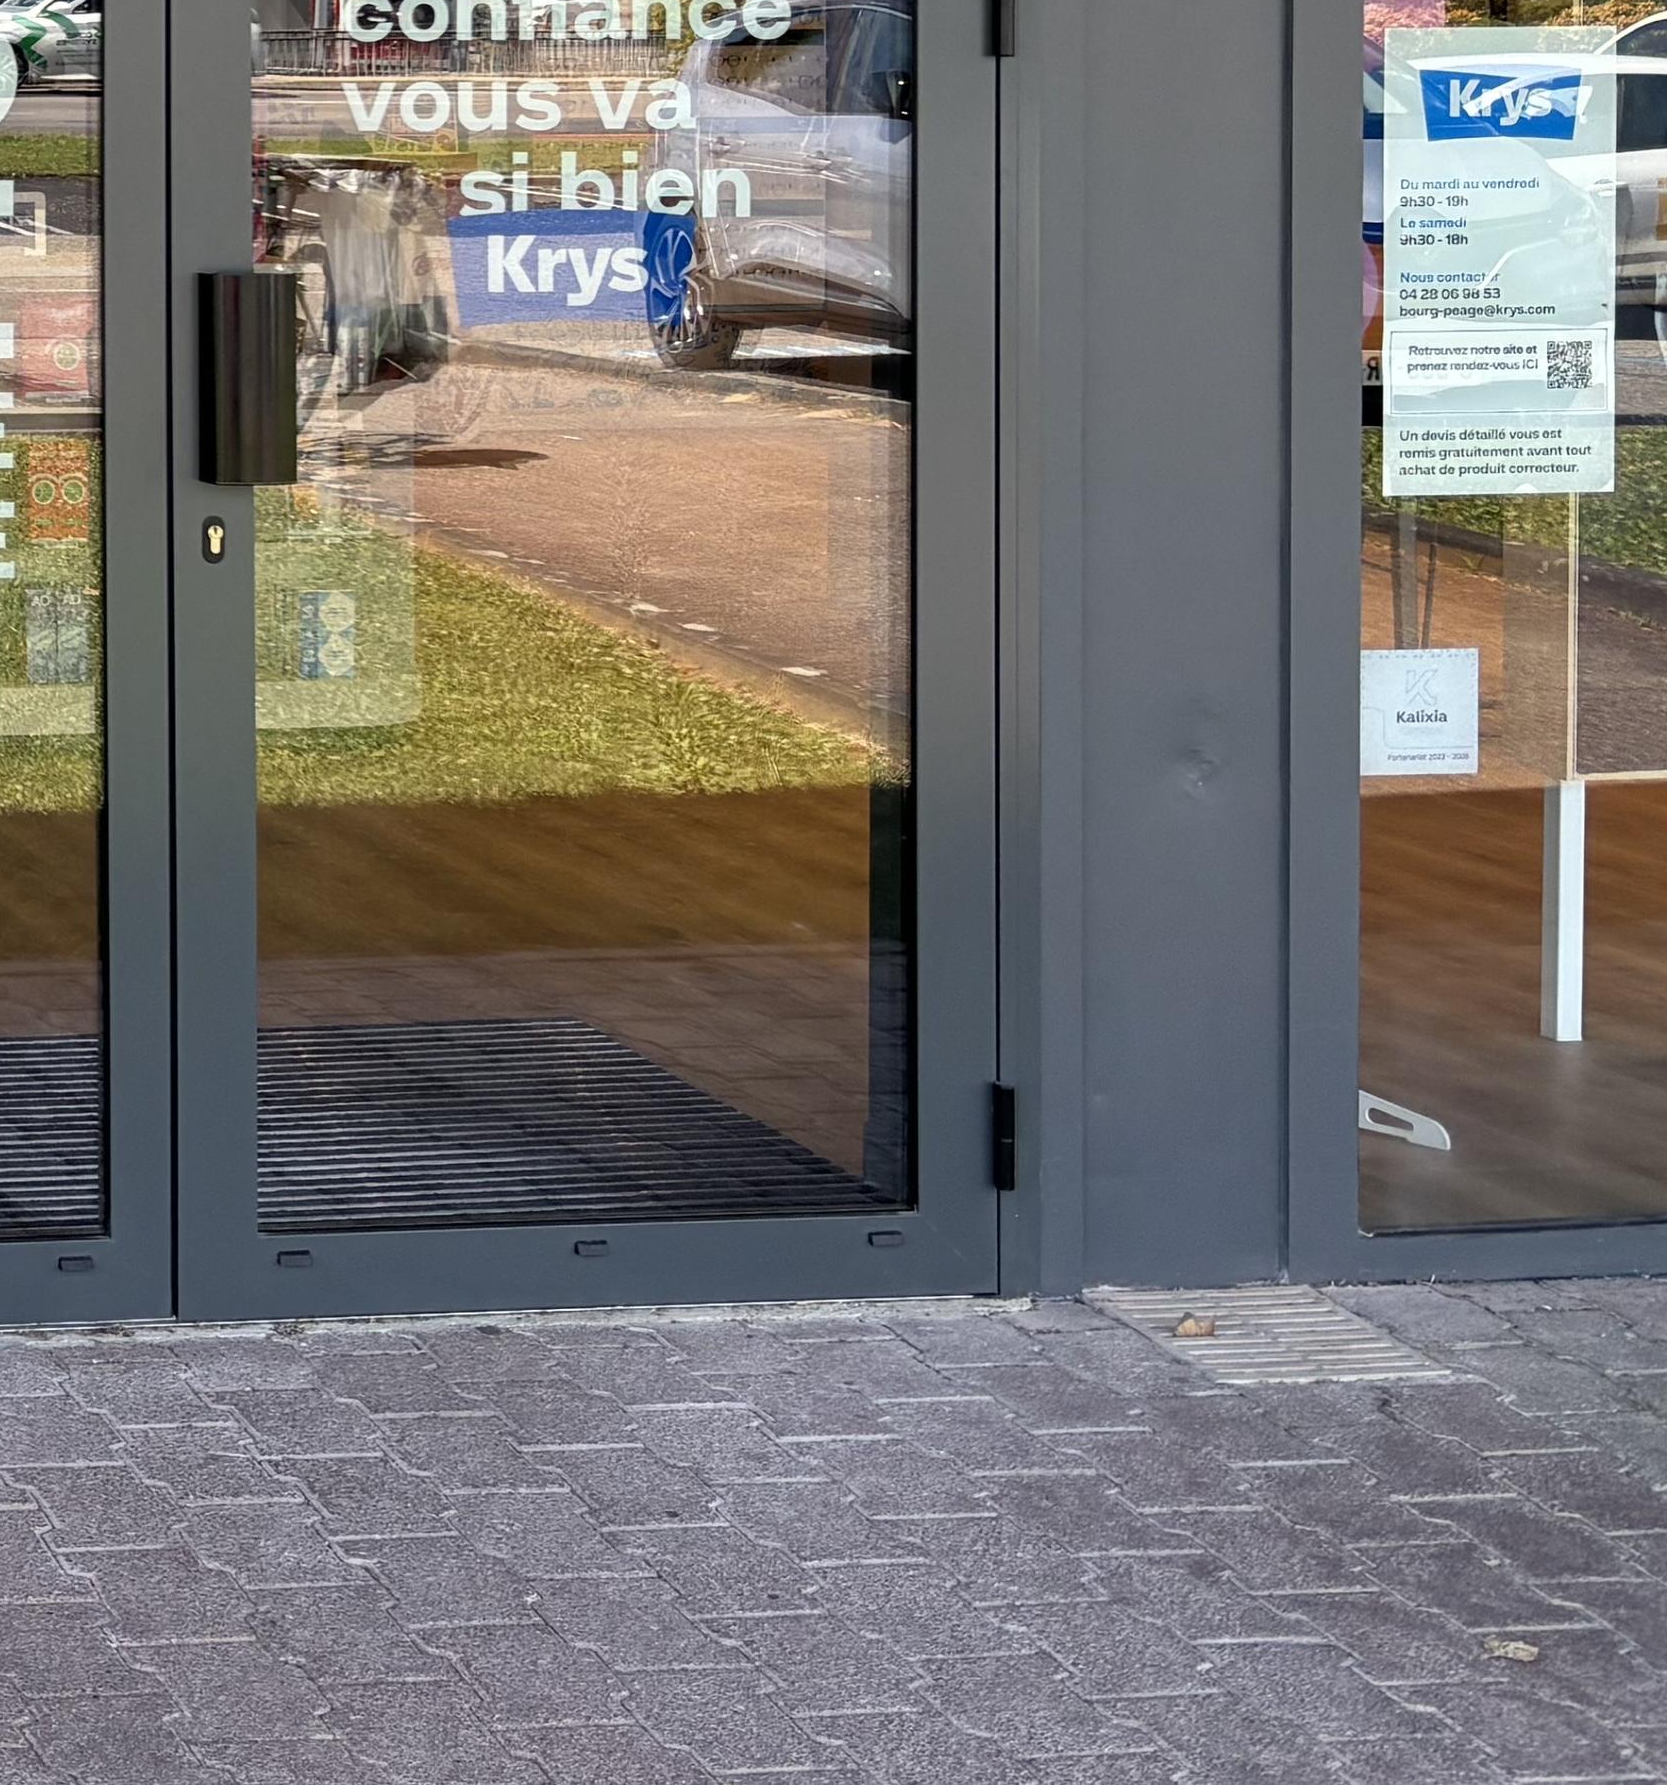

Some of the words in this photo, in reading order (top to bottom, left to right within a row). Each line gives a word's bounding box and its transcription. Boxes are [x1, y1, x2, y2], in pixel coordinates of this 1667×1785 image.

[342, 79, 565, 134] vous
[589, 78, 696, 131] va
[1450, 79, 1553, 127] Krys
[459, 151, 528, 217] si
[562, 149, 752, 219] bien
[1400, 179, 1419, 190] Du
[1423, 177, 1460, 190] mardi
[1463, 180, 1480, 189] au
[1482, 177, 1540, 189] vendredi
[1399, 196, 1434, 207] 9h30
[1446, 195, 1469, 207] 19h
[1400, 217, 1416, 228] Le
[1419, 217, 1467, 228] samedi
[1399, 234, 1434, 246] 9h30
[1446, 233, 1469, 245] 18h
[487, 234, 648, 307] Krys
[1400, 272, 1434, 283] Nous
[1436, 272, 1501, 283] contactr
[1399, 288, 1417, 300] 04
[1420, 288, 1438, 299] 28
[1441, 288, 1459, 299] 06
[1483, 287, 1501, 299] 53
[1408, 345, 1467, 356] Retrouvez
[1470, 345, 1500, 356] notre
[1502, 344, 1523, 355] site
[1526, 344, 1537, 354] et
[1407, 362, 1447, 373] prenez
[1450, 359, 1520, 371] rendez-vous
[1522, 358, 1538, 369] ICI
[1399, 430, 1418, 441] Un
[1421, 429, 1456, 441] devis
[1459, 428, 1506, 441] détaillé
[1509, 430, 1540, 439] vous
[1543, 428, 1562, 439] est
[1399, 447, 1436, 459] remis
[1438, 445, 1524, 460] gratuitement
[1526, 445, 1563, 456] avant
[1566, 445, 1592, 455] tout
[1399, 464, 1436, 475] achat
[1439, 464, 1455, 475] de
[1458, 463, 1506, 477] produit
[1508, 462, 1579, 474] correcteur.
[1396, 710, 1448, 723] Kalixia
